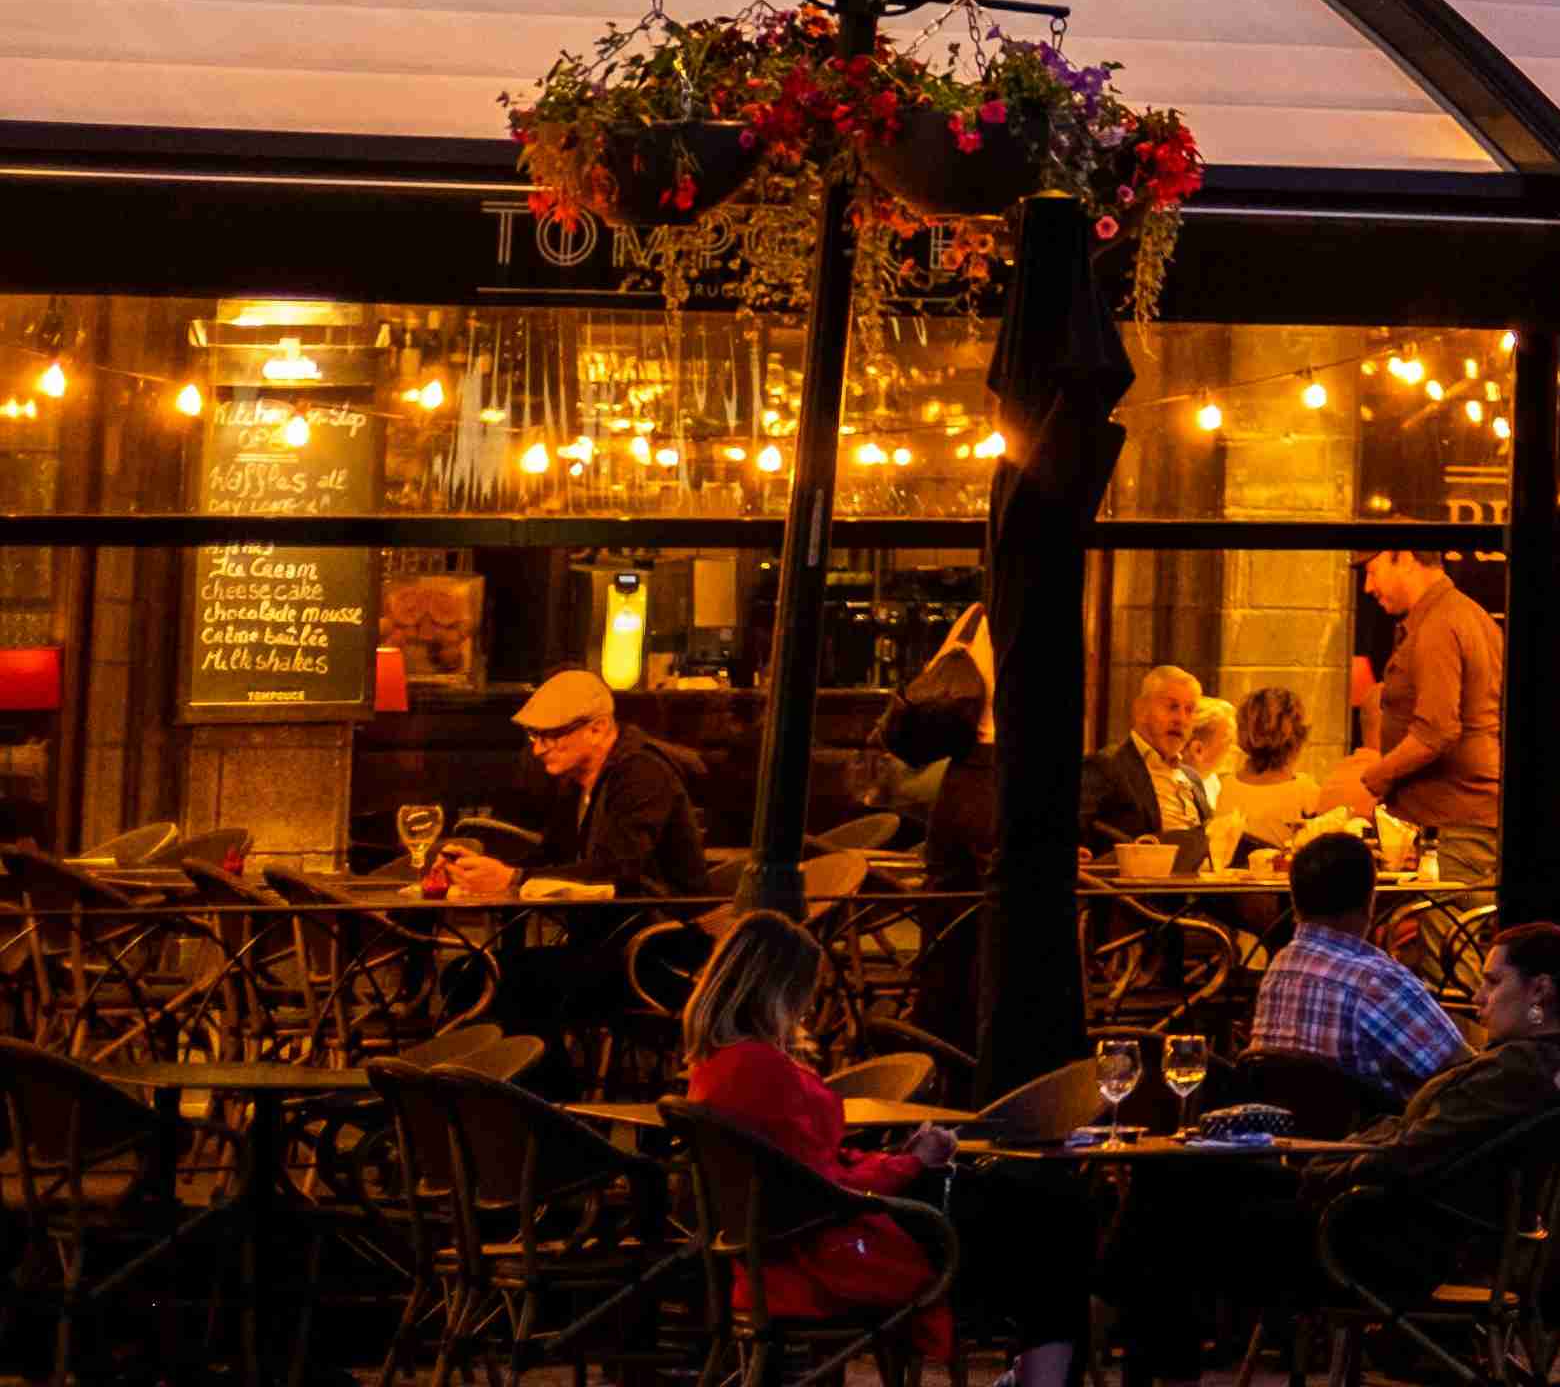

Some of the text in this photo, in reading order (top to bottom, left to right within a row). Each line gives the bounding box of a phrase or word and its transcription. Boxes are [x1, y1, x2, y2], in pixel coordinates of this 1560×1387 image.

[210, 462, 349, 498] Waffles all
[209, 556, 319, 580] Ice Cream
[301, 606, 364, 625] mousse
